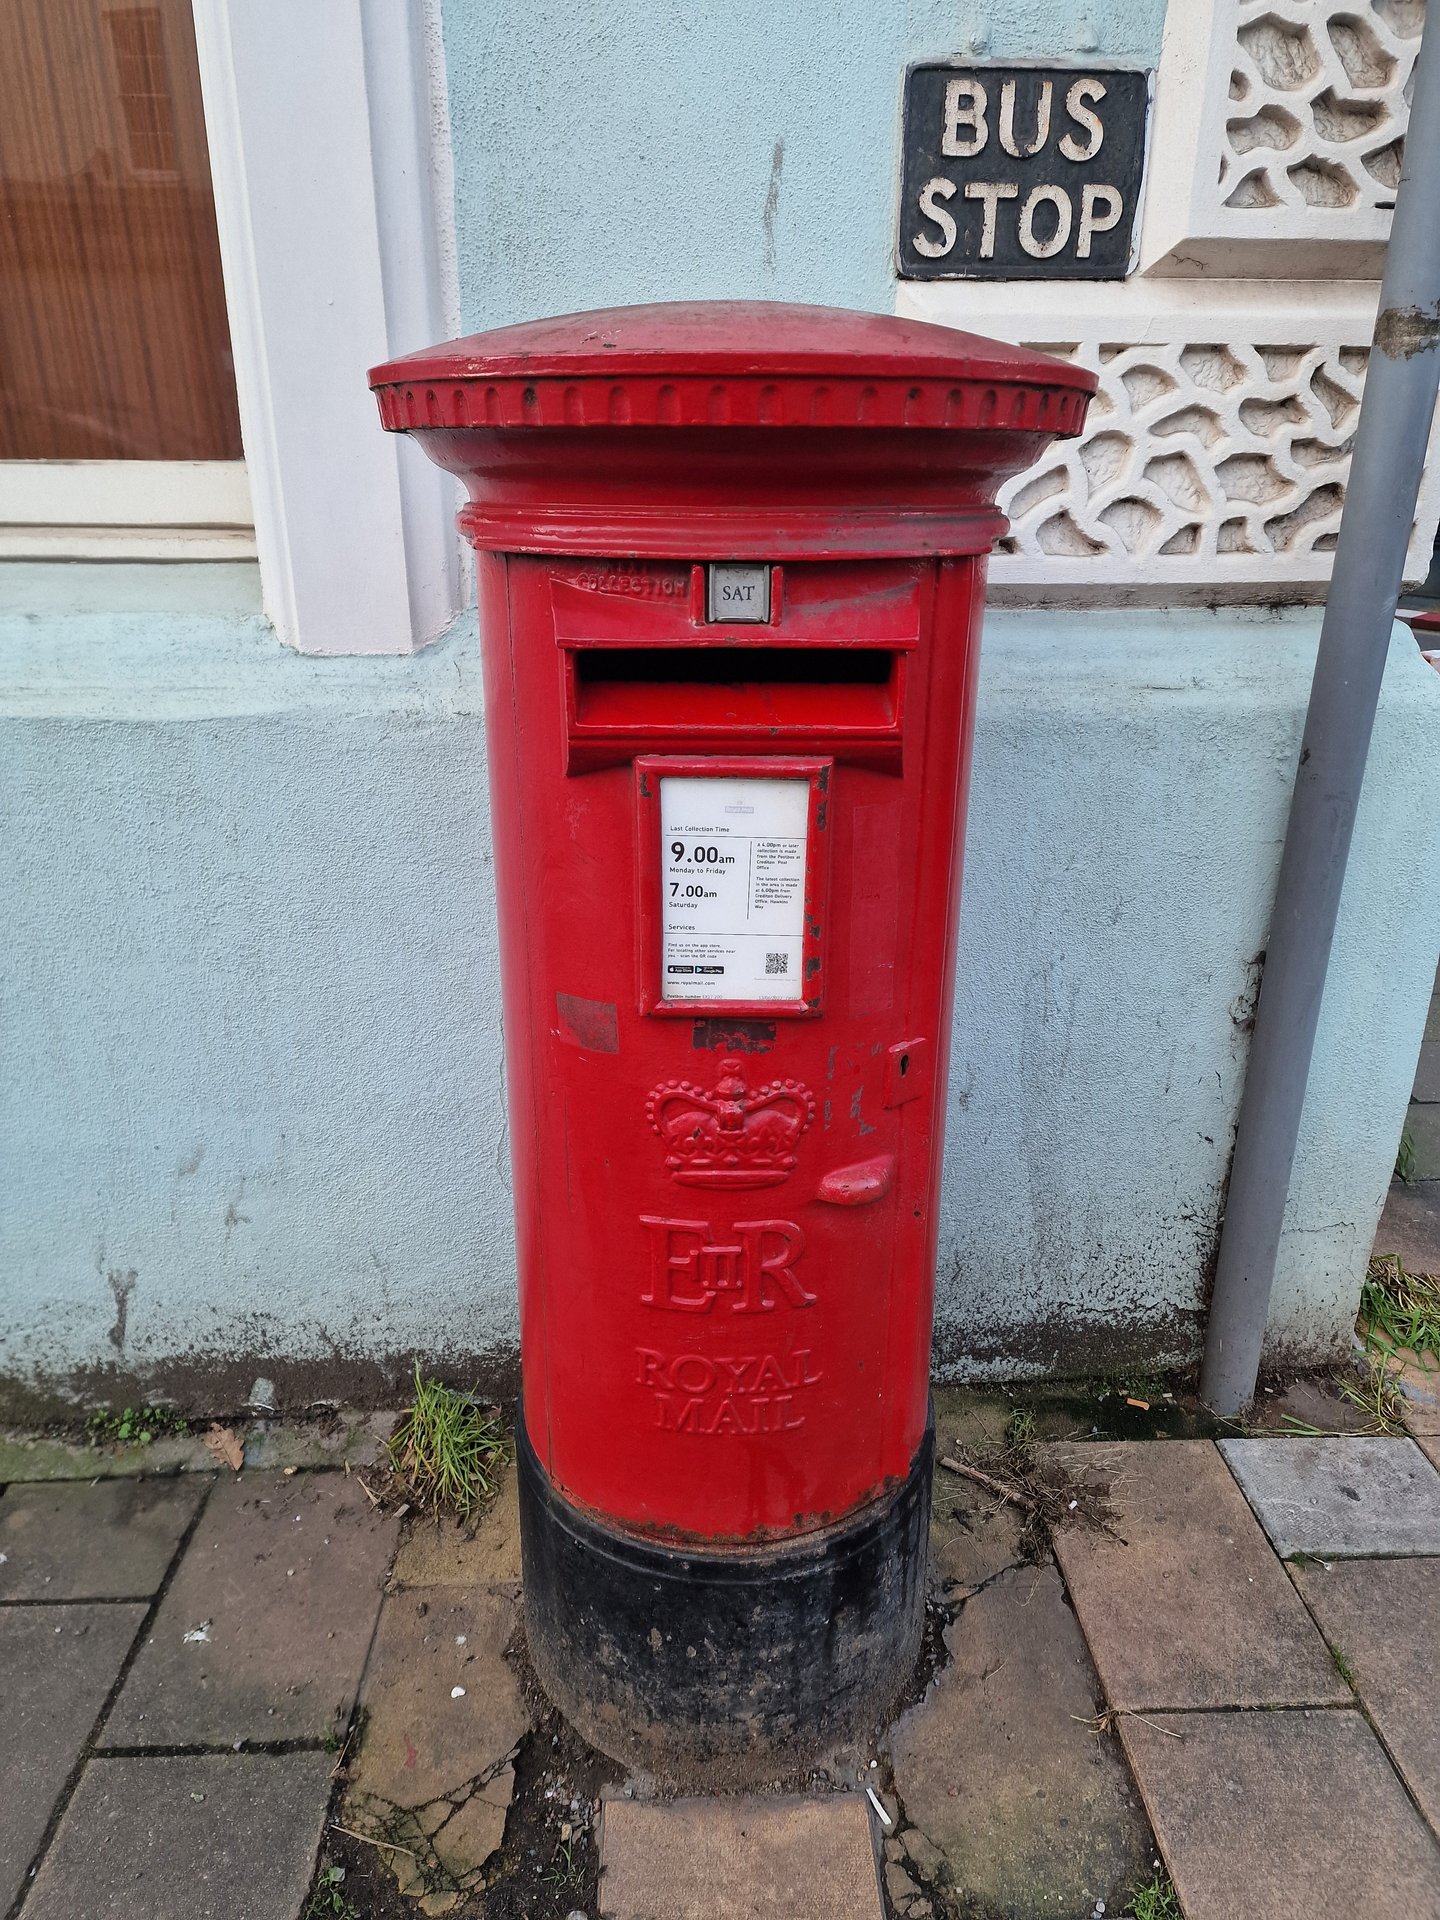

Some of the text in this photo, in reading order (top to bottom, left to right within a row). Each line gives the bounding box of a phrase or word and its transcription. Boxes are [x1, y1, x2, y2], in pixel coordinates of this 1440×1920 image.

[941, 78, 1108, 162] BUS
[912, 176, 1123, 259] STOP
[576, 572, 685, 597] COLLECTION
[722, 584, 756, 602] SAT
[670, 841, 735, 864] 9.00am
[669, 882, 718, 898] 7.00am
[635, 1346, 823, 1394] ROYAL
[654, 1393, 805, 1436] MAIL
